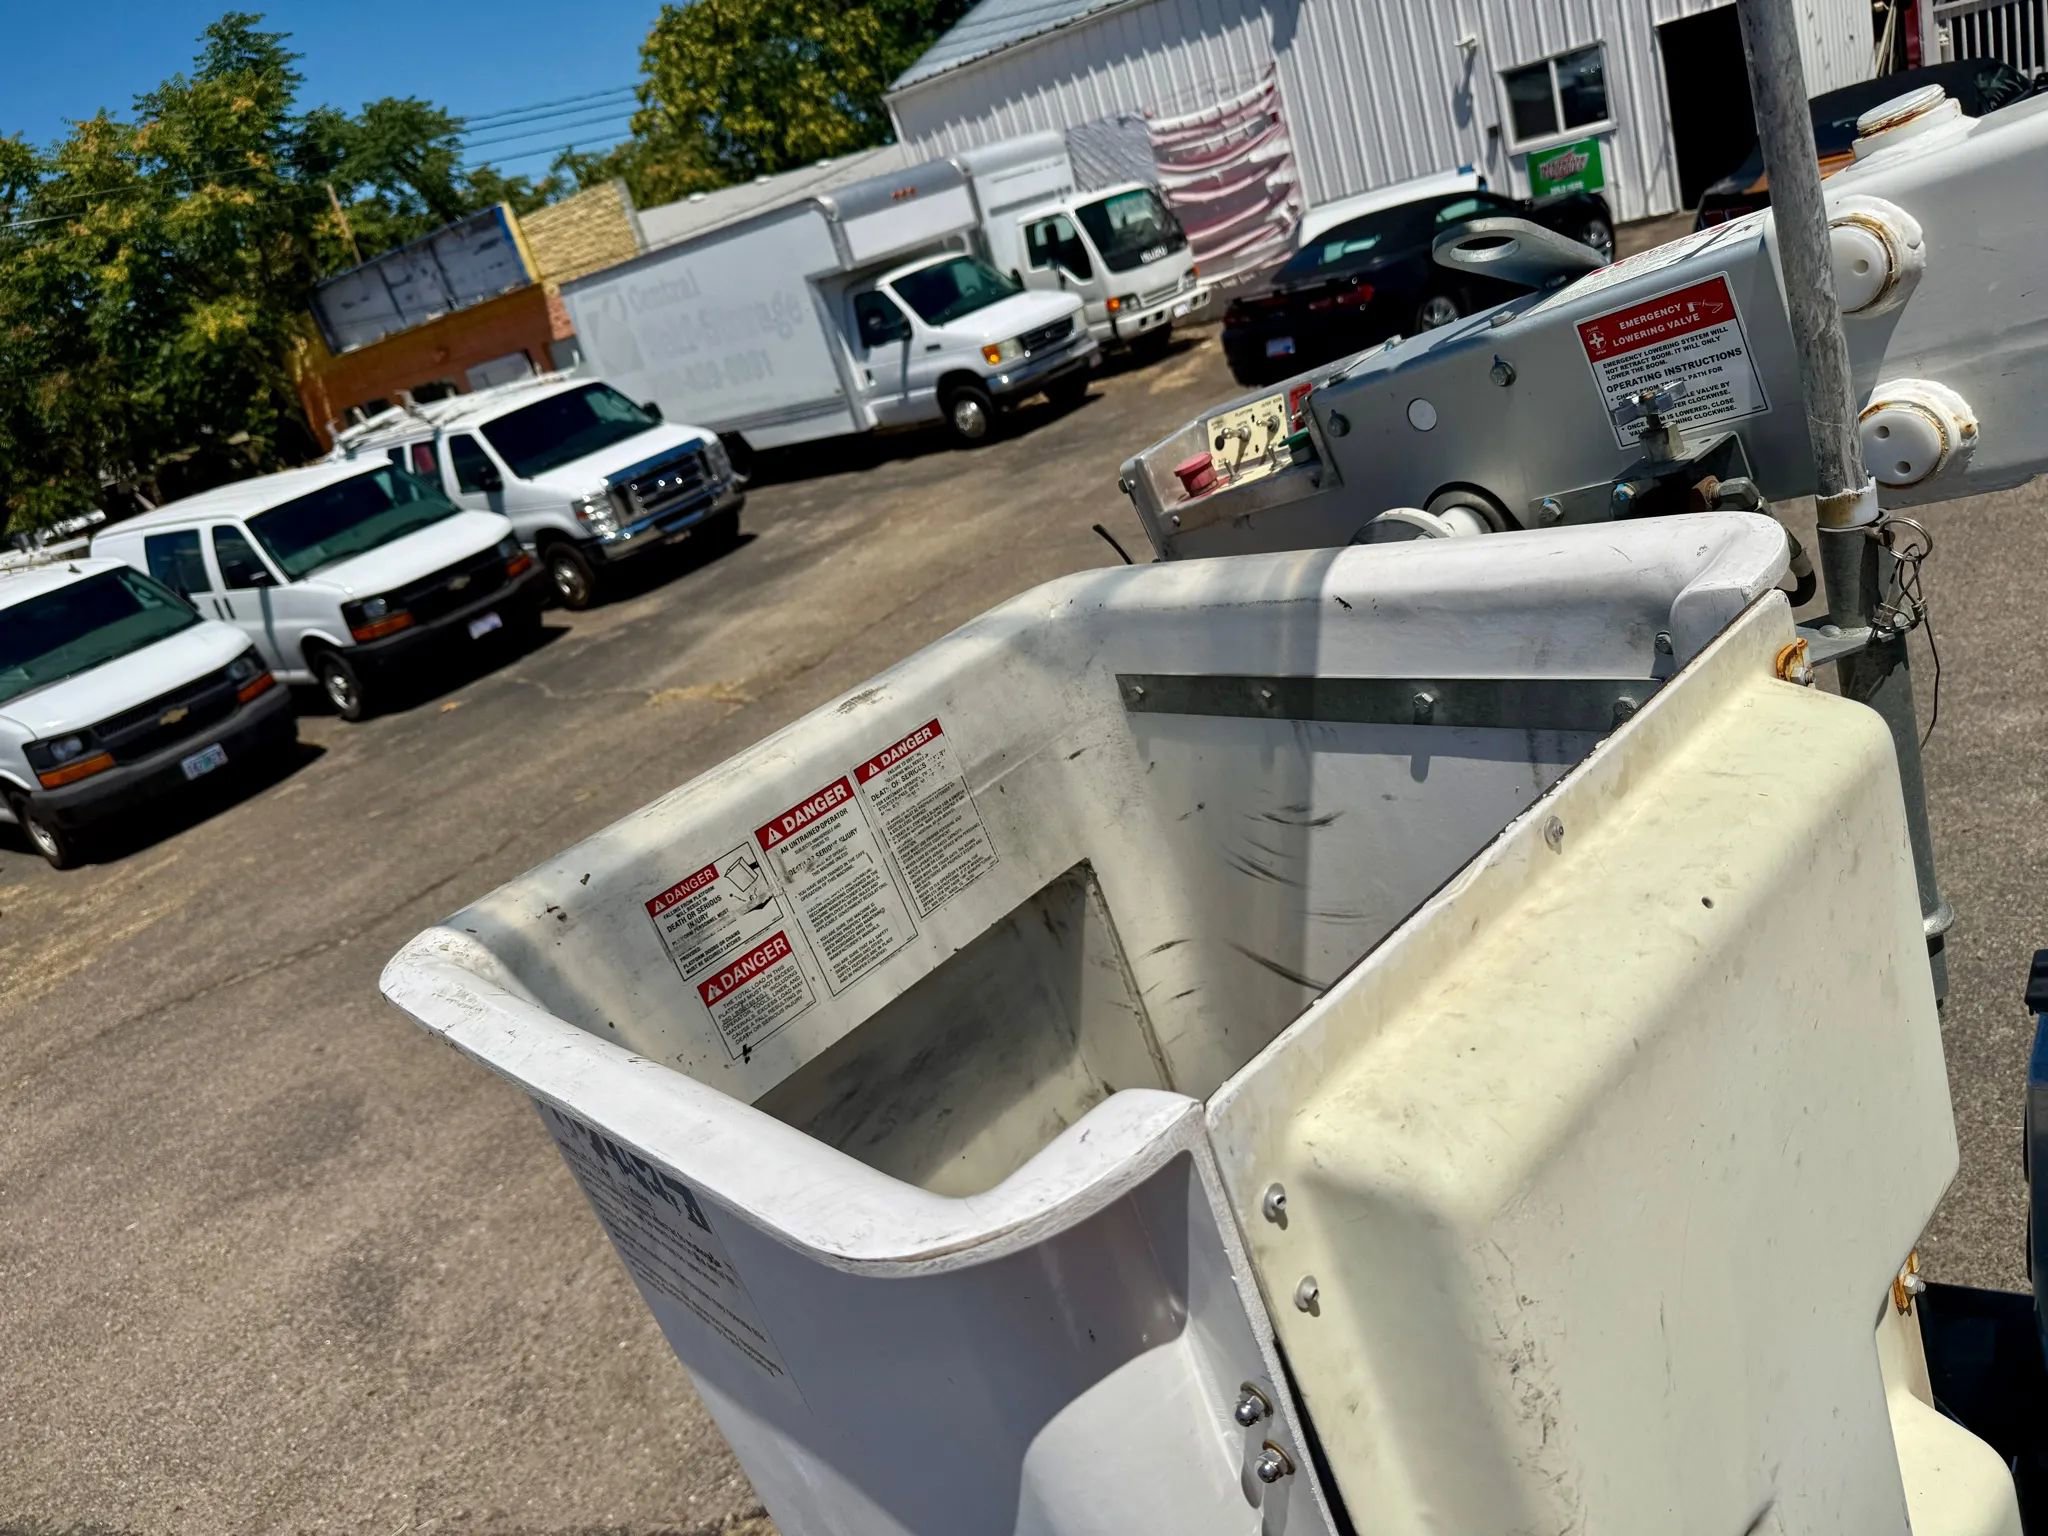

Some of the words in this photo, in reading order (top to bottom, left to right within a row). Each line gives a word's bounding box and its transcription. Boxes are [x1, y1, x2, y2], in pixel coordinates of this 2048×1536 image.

[626, 267, 700, 314] Central
[1612, 324, 1665, 346] LOWERING
[1666, 312, 1700, 329] VALVE
[1619, 303, 1682, 329] EMERGENCY
[1602, 352, 1642, 368] EMERGENCY
[1643, 341, 1679, 356] LOWERING
[1680, 331, 1709, 345] SYSTEM
[1710, 325, 1728, 336] WILL
[1604, 366, 1618, 375] NOT
[1619, 357, 1649, 370] RETRACT
[1650, 350, 1673, 361] BOOM.
[1682, 341, 1700, 351] WILL
[1700, 335, 1721, 346] ONLY
[1606, 370, 1662, 393] OPERATING
[1663, 347, 1742, 376] INSTRUCTIONS
[1607, 370, 1629, 381] LOWER
[1630, 365, 1644, 374] THE
[1645, 358, 1667, 369] BOOM.
[1688, 370, 1706, 380] PATH
[1707, 365, 1723, 374] FOR
[1687, 388, 1730, 404] CLOCKWISE.
[1696, 384, 1717, 395] VALVE
[1718, 380, 1730, 388] BY
[1675, 403, 1710, 418] LOWERED,
[1710, 397, 1734, 408] CLOSE
[1693, 403, 1736, 419] CLOCKWISE.
[1626, 421, 1645, 430] ONCE
[879, 726, 932, 766] DANGER
[780, 783, 848, 833] DANGER
[779, 845, 788, 854] AN
[787, 824, 821, 848] UNTRAINED
[819, 807, 848, 829] OPERATOR
[664, 868, 714, 904] DANGER
[680, 898, 693, 908] FROM
[692, 885, 715, 901] PLATFORM
[666, 916, 686, 932] DEATH
[685, 910, 696, 920] OR
[695, 894, 722, 914] SERIOUS
[675, 908, 687, 918] WILL
[686, 899, 702, 911] RESULT
[687, 912, 709, 929] INJURY
[693, 915, 717, 932] PERSONNEL
[716, 907, 729, 918] MUST
[682, 952, 704, 969] PLATFORM
[704, 943, 719, 955] DOORS
[724, 929, 740, 942] CHAINS
[685, 963, 698, 974] MUST
[697, 959, 704, 967] BE
[703, 947, 723, 962] SECURELY
[719, 936, 788, 989] DANGER
[717, 997, 747, 1019] PLATFORM
[746, 987, 762, 1000] MUST
[762, 978, 774, 989] NOT
[773, 964, 794, 981] EXCEED
[722, 998, 734, 1009] THE
[734, 987, 750, 1000] TOTAL
[750, 976, 766, 989] LOAD
[765, 972, 772, 980] IN
[772, 964, 784, 975] THIS
[768, 970, 798, 991] INCLUDING
[788, 974, 801, 985] AND
[756, 998, 777, 1015] EXCESS
[777, 988, 792, 1000] LOAD
[792, 980, 803, 990] MAY
[731, 1024, 750, 1040] CAUSE
[754, 1012, 768, 1023] FALL
[767, 992, 796, 1014] RESULTING
[735, 1029, 753, 1044] DEATH
[752, 1023, 762, 1032] OR
[761, 1007, 784, 1026] SERIOUS
